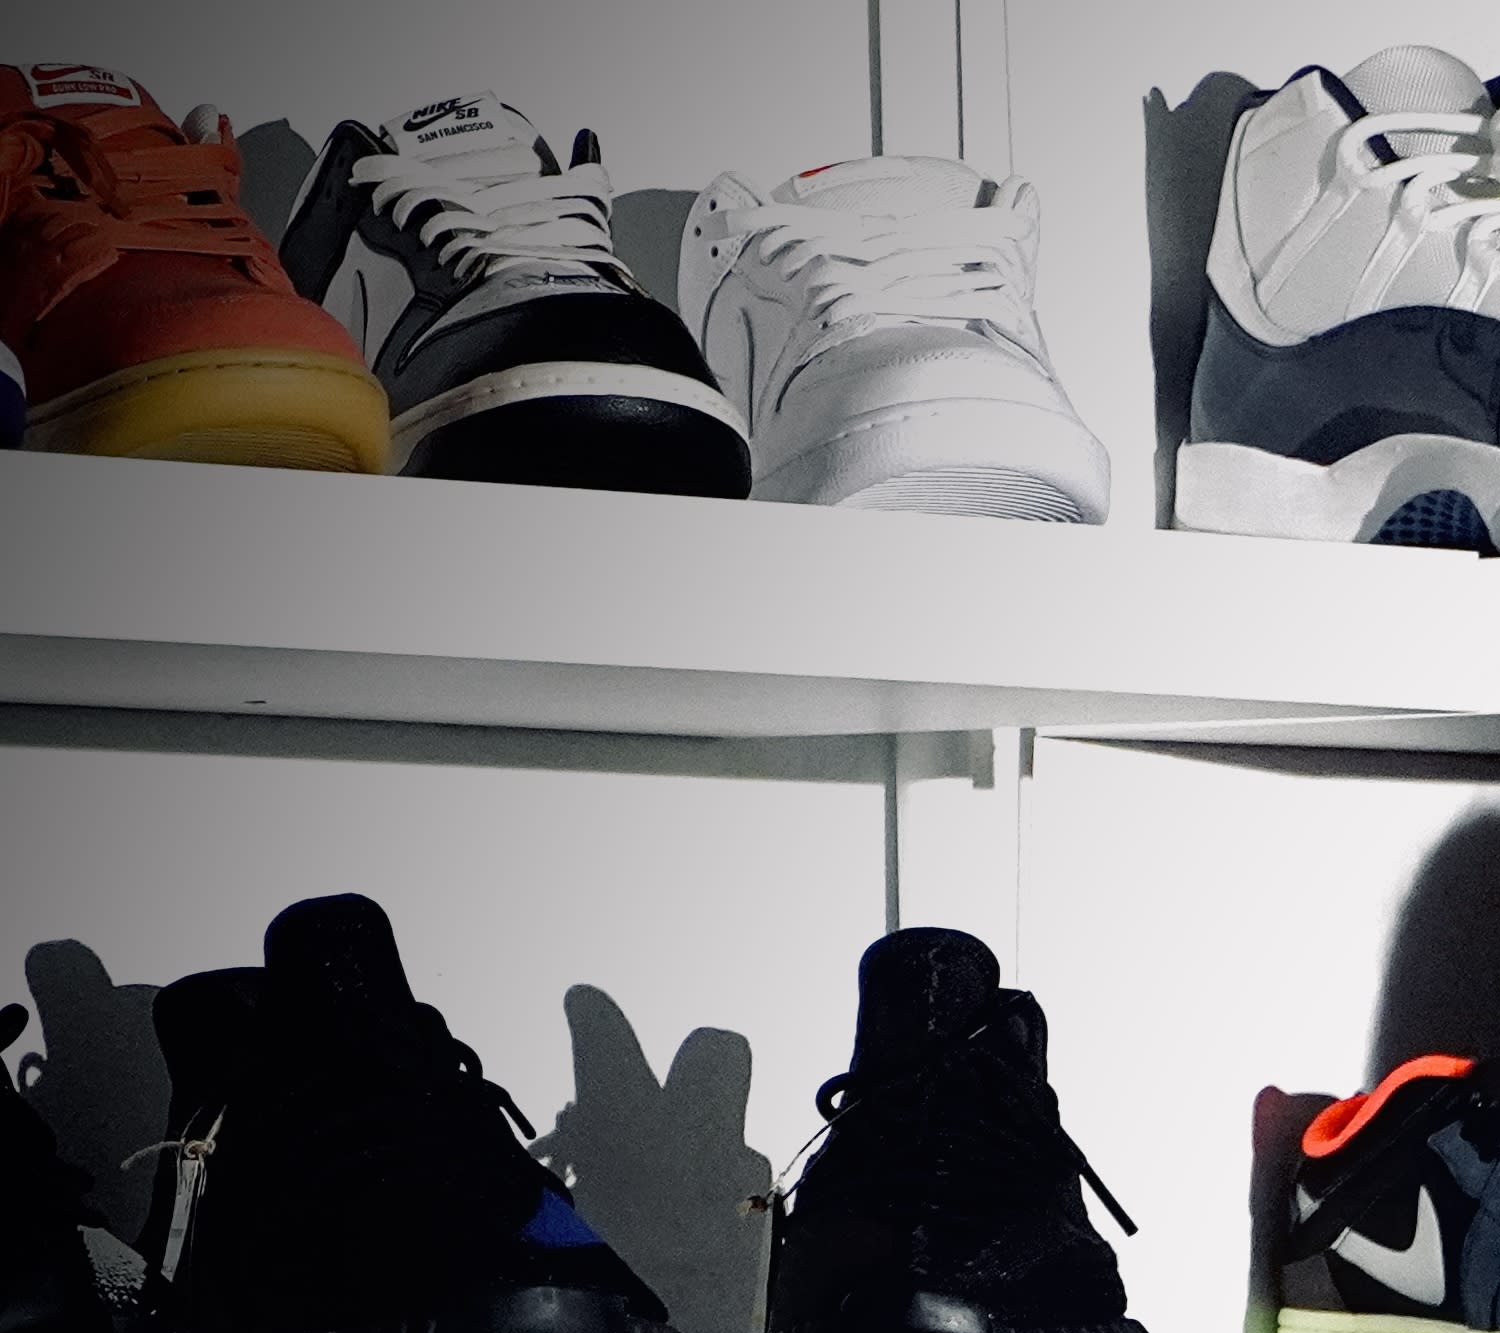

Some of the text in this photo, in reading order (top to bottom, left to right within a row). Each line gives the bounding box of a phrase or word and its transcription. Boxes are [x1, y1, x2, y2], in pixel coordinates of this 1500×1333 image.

[413, 97, 461, 120] NIKE
[455, 107, 480, 120] SB
[417, 121, 494, 143] SAN FRANCISCO
